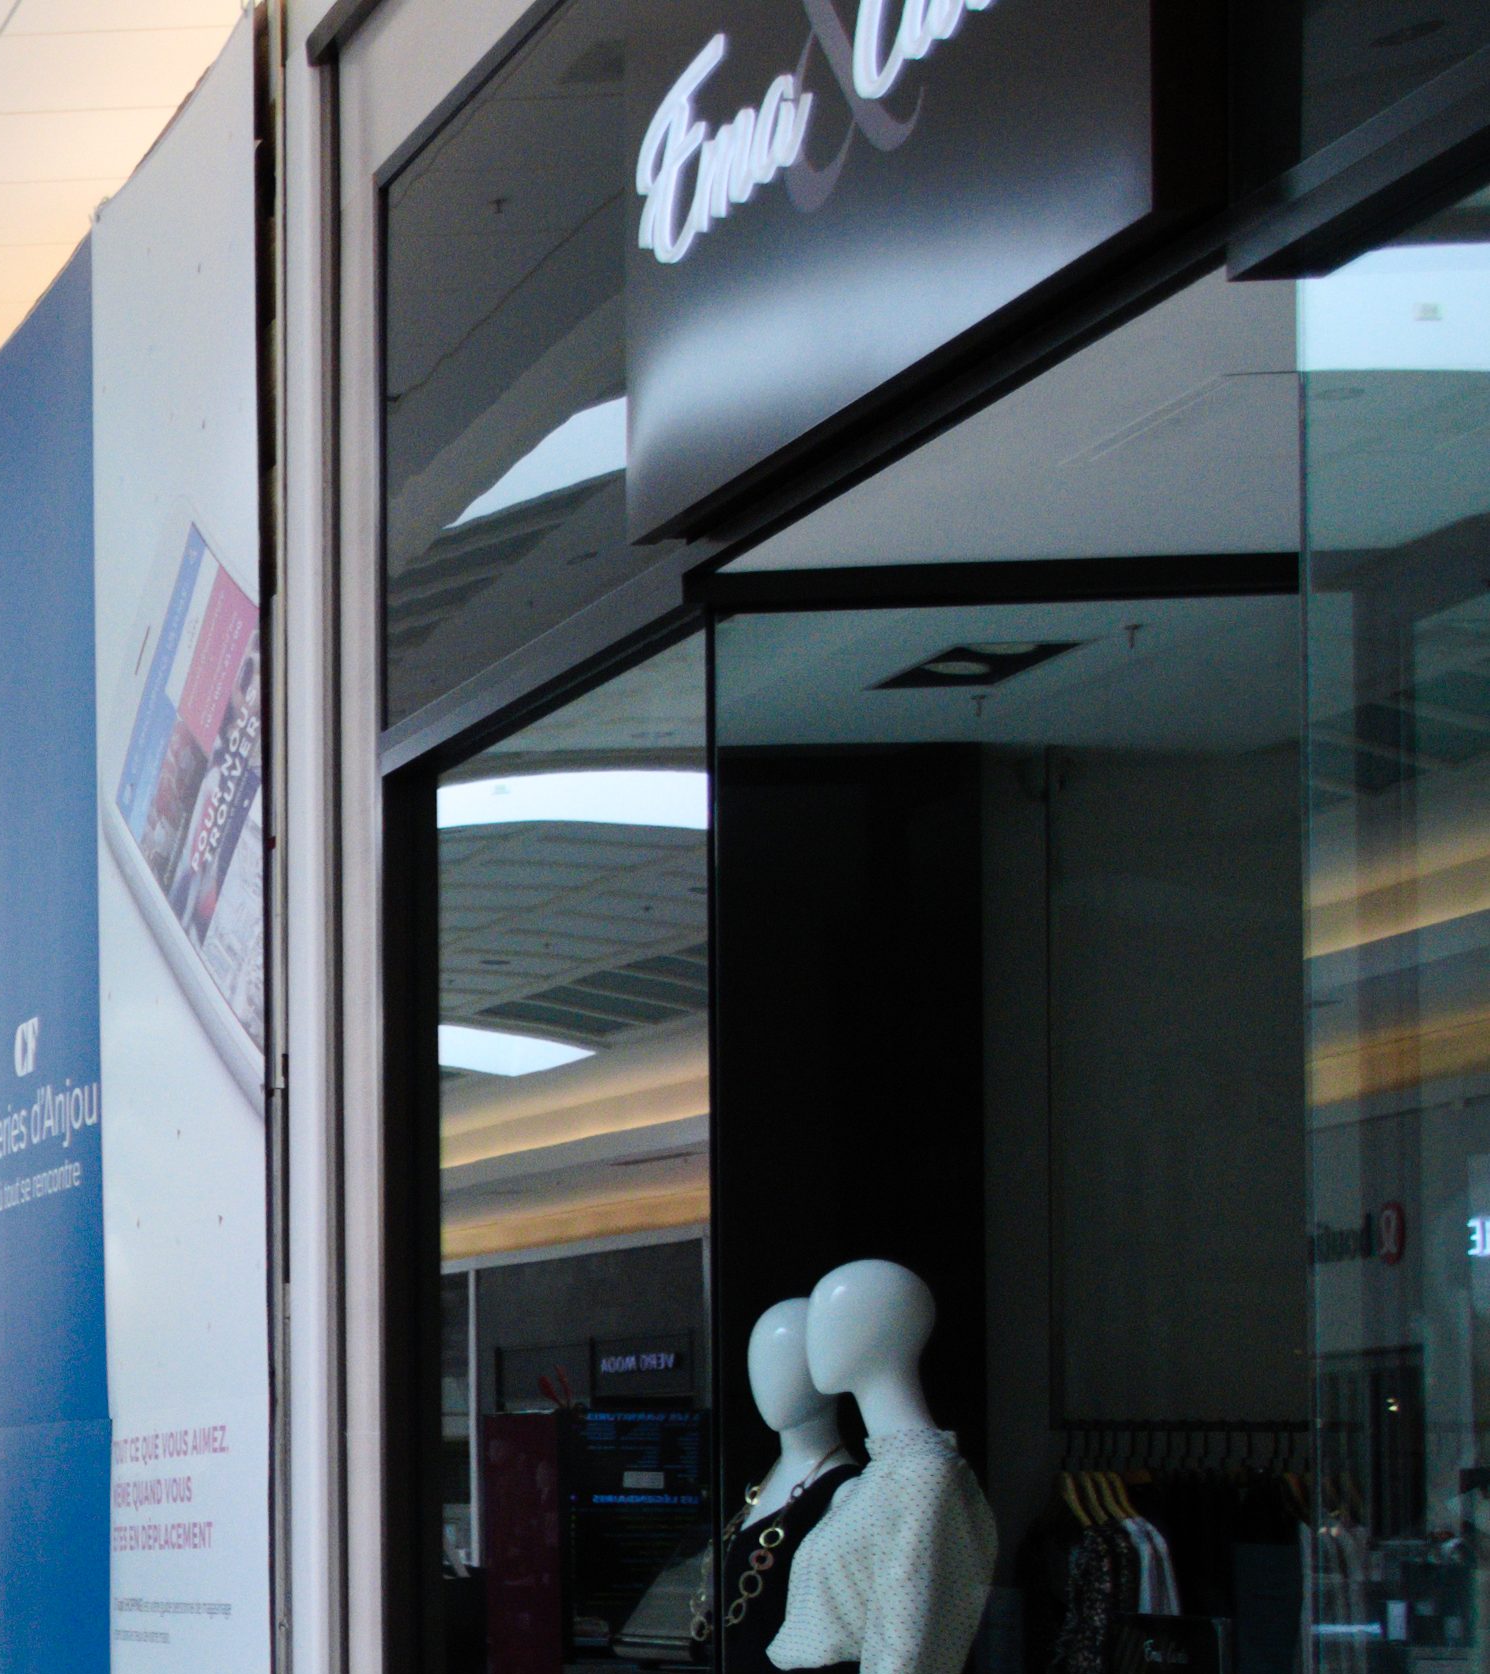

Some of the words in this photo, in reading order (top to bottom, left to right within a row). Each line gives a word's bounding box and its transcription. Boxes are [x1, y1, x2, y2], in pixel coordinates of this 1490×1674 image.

[636, 33, 814, 264] Ema
[203, 716, 261, 866] TROUVER
[191, 788, 225, 874] POUR
[30, 1078, 98, 1148] d'Anjou
[32, 1160, 81, 1198] rencontre
[129, 1436, 140, 1462] CE
[141, 1433, 160, 1466] QUE
[161, 1429, 188, 1459] VOUS
[132, 1478, 162, 1512] QUAND
[164, 1475, 193, 1504] VOUS
